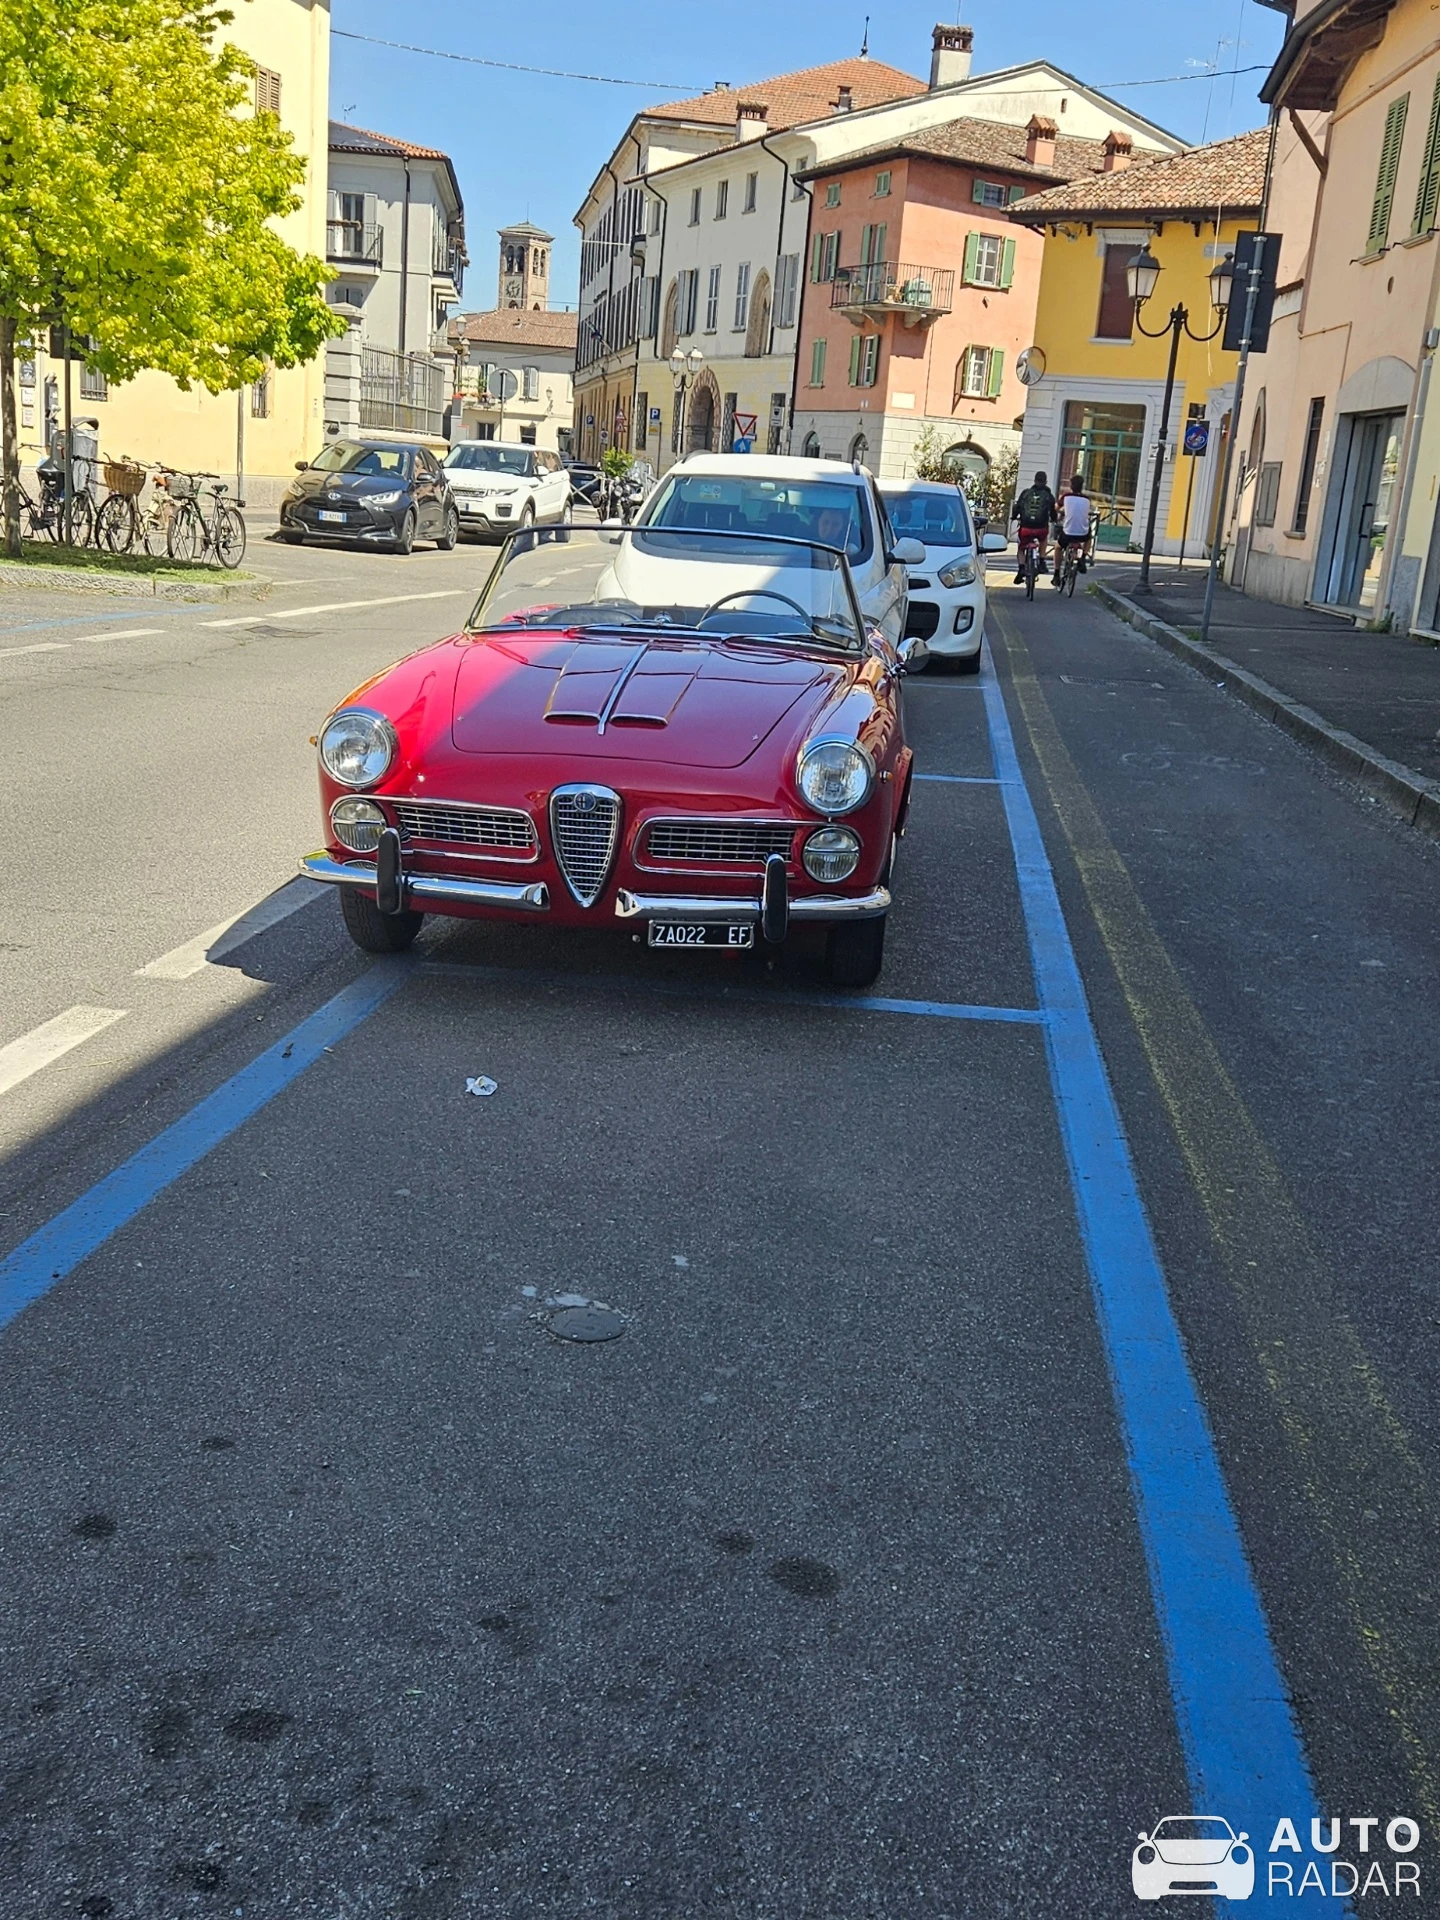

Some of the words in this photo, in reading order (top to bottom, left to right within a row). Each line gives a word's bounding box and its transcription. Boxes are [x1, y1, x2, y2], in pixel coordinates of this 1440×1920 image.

[651, 409, 659, 419] P
[655, 926, 706, 943] ZA022
[728, 926, 749, 944] EF
